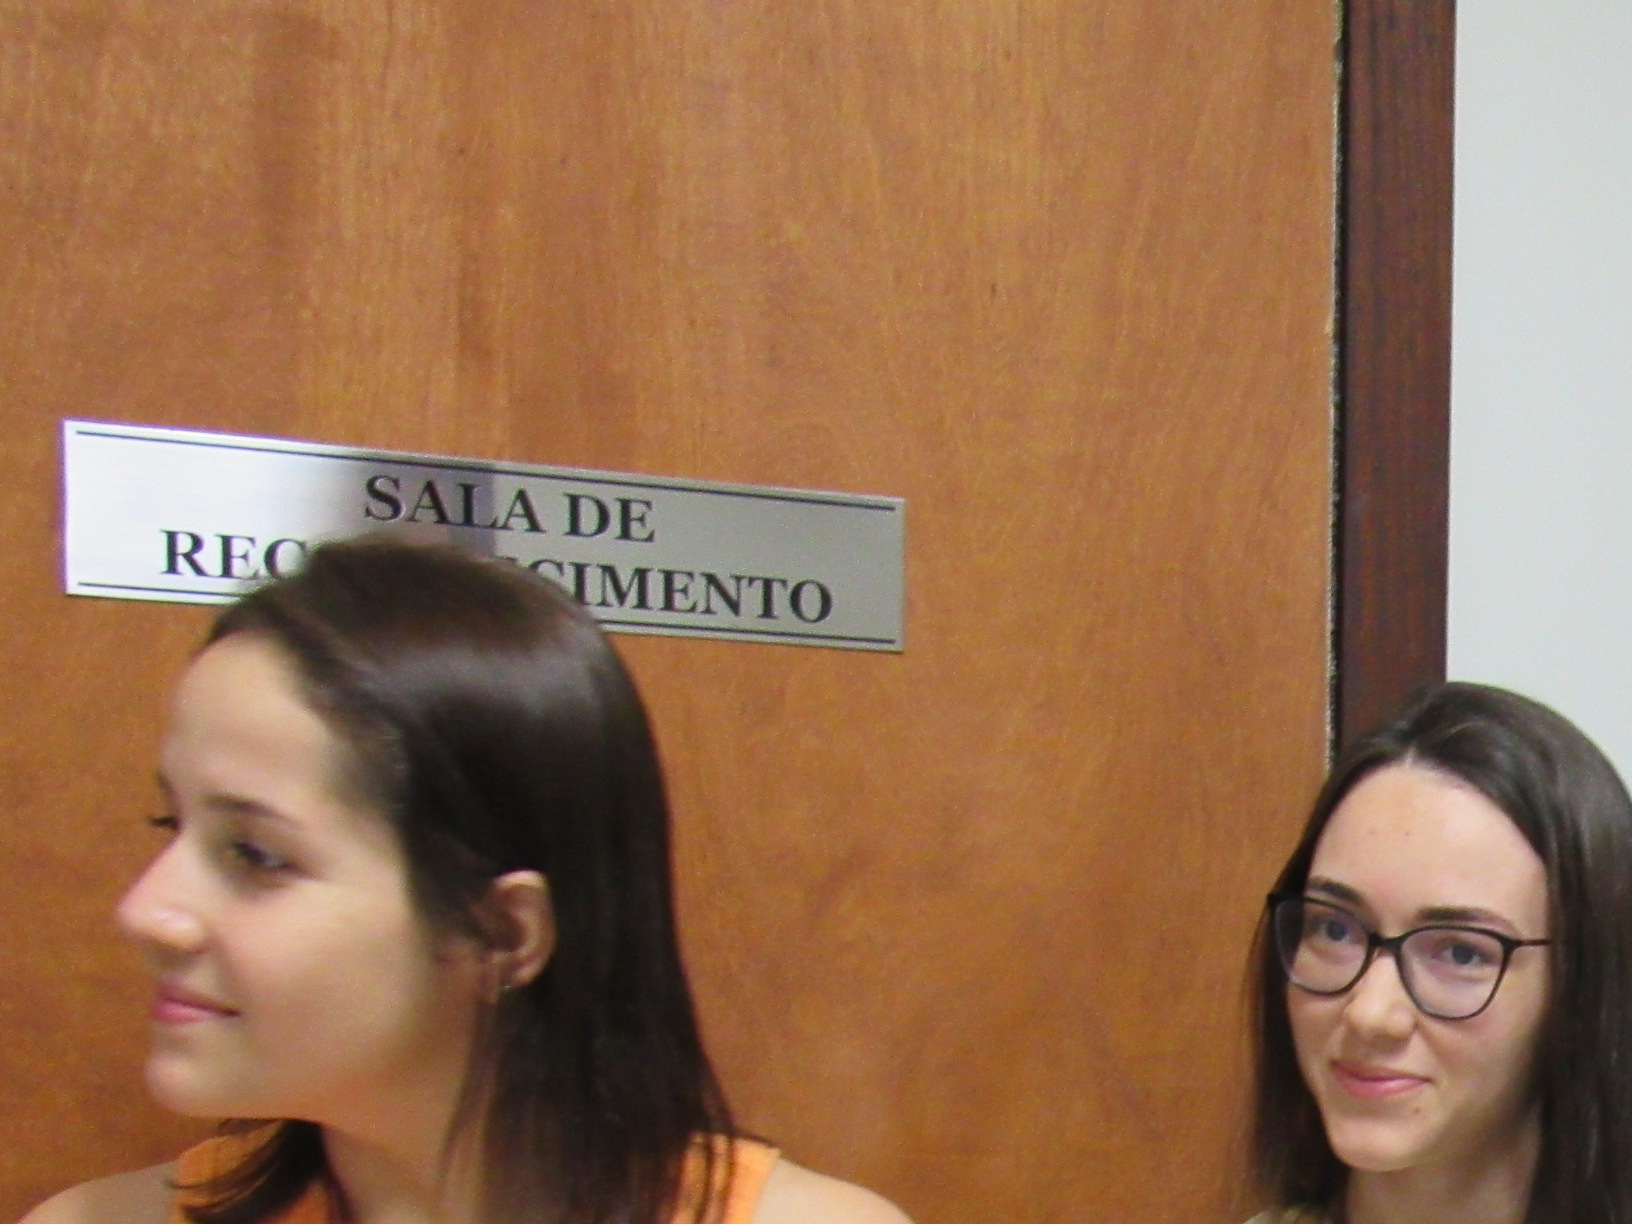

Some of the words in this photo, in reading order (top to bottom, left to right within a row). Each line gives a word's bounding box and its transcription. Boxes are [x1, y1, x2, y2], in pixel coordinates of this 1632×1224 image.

[365, 474, 546, 533] SALA
[562, 492, 656, 542] DE
[159, 529, 832, 623] RECIMENTO
